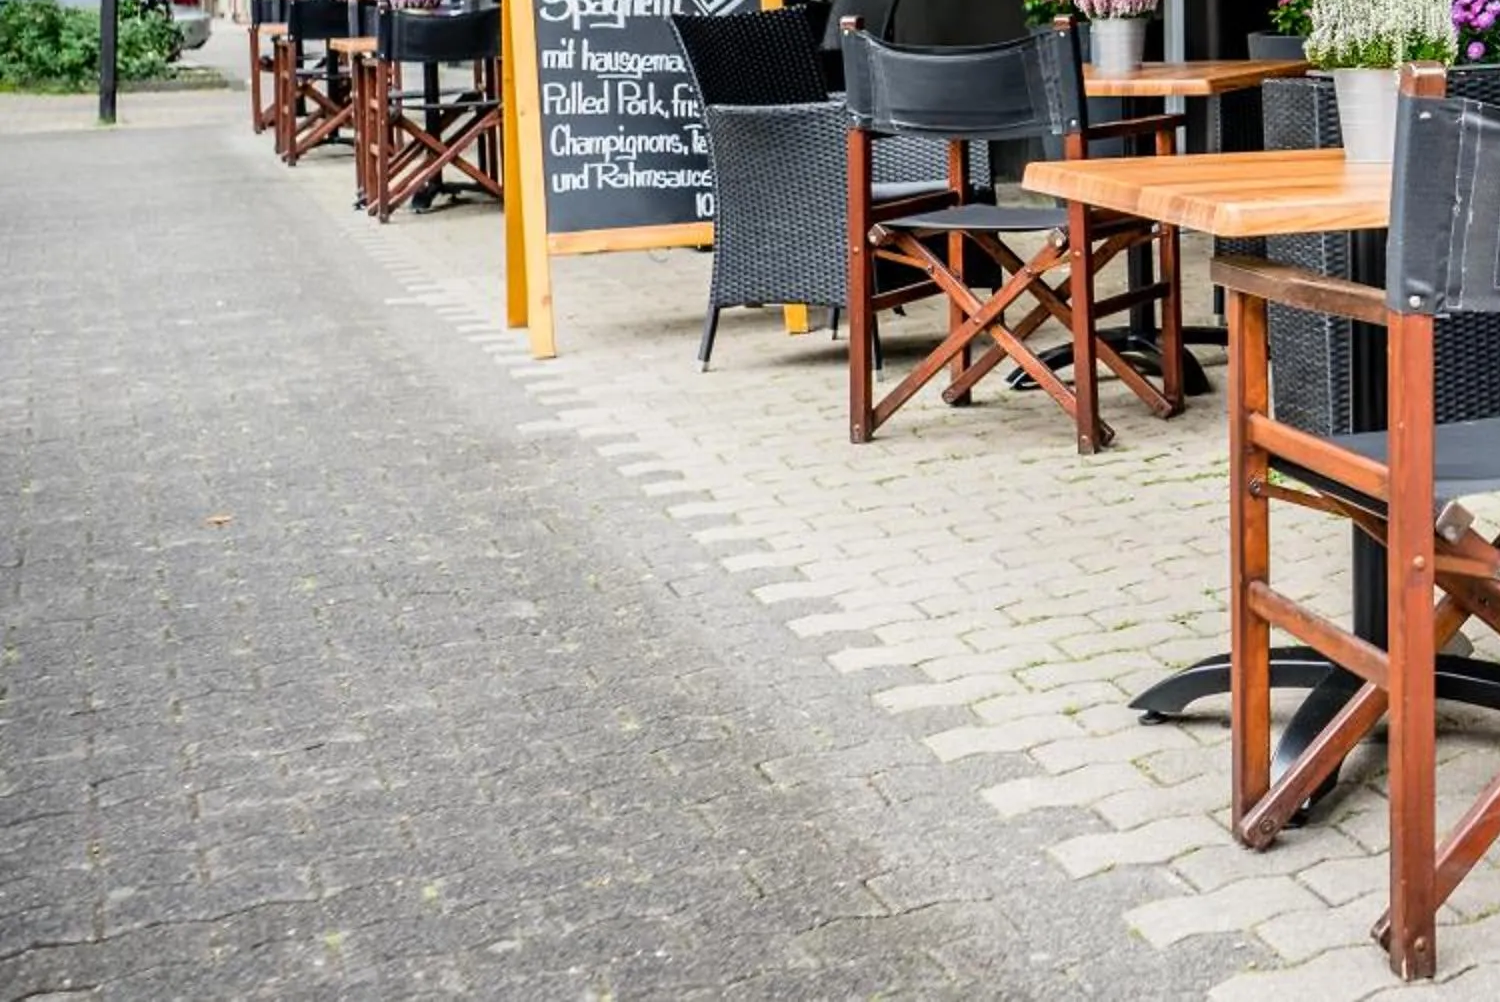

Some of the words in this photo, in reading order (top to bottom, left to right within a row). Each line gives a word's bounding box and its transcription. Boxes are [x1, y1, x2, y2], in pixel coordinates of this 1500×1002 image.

[542, 38, 576, 69] mit
[543, 80, 609, 115] Pulled
[617, 80, 670, 119] Pork,
[551, 124, 689, 163] Champignons,
[552, 163, 589, 193] und
[589, 162, 713, 189] Rahmsauce
[695, 193, 714, 217] 10
